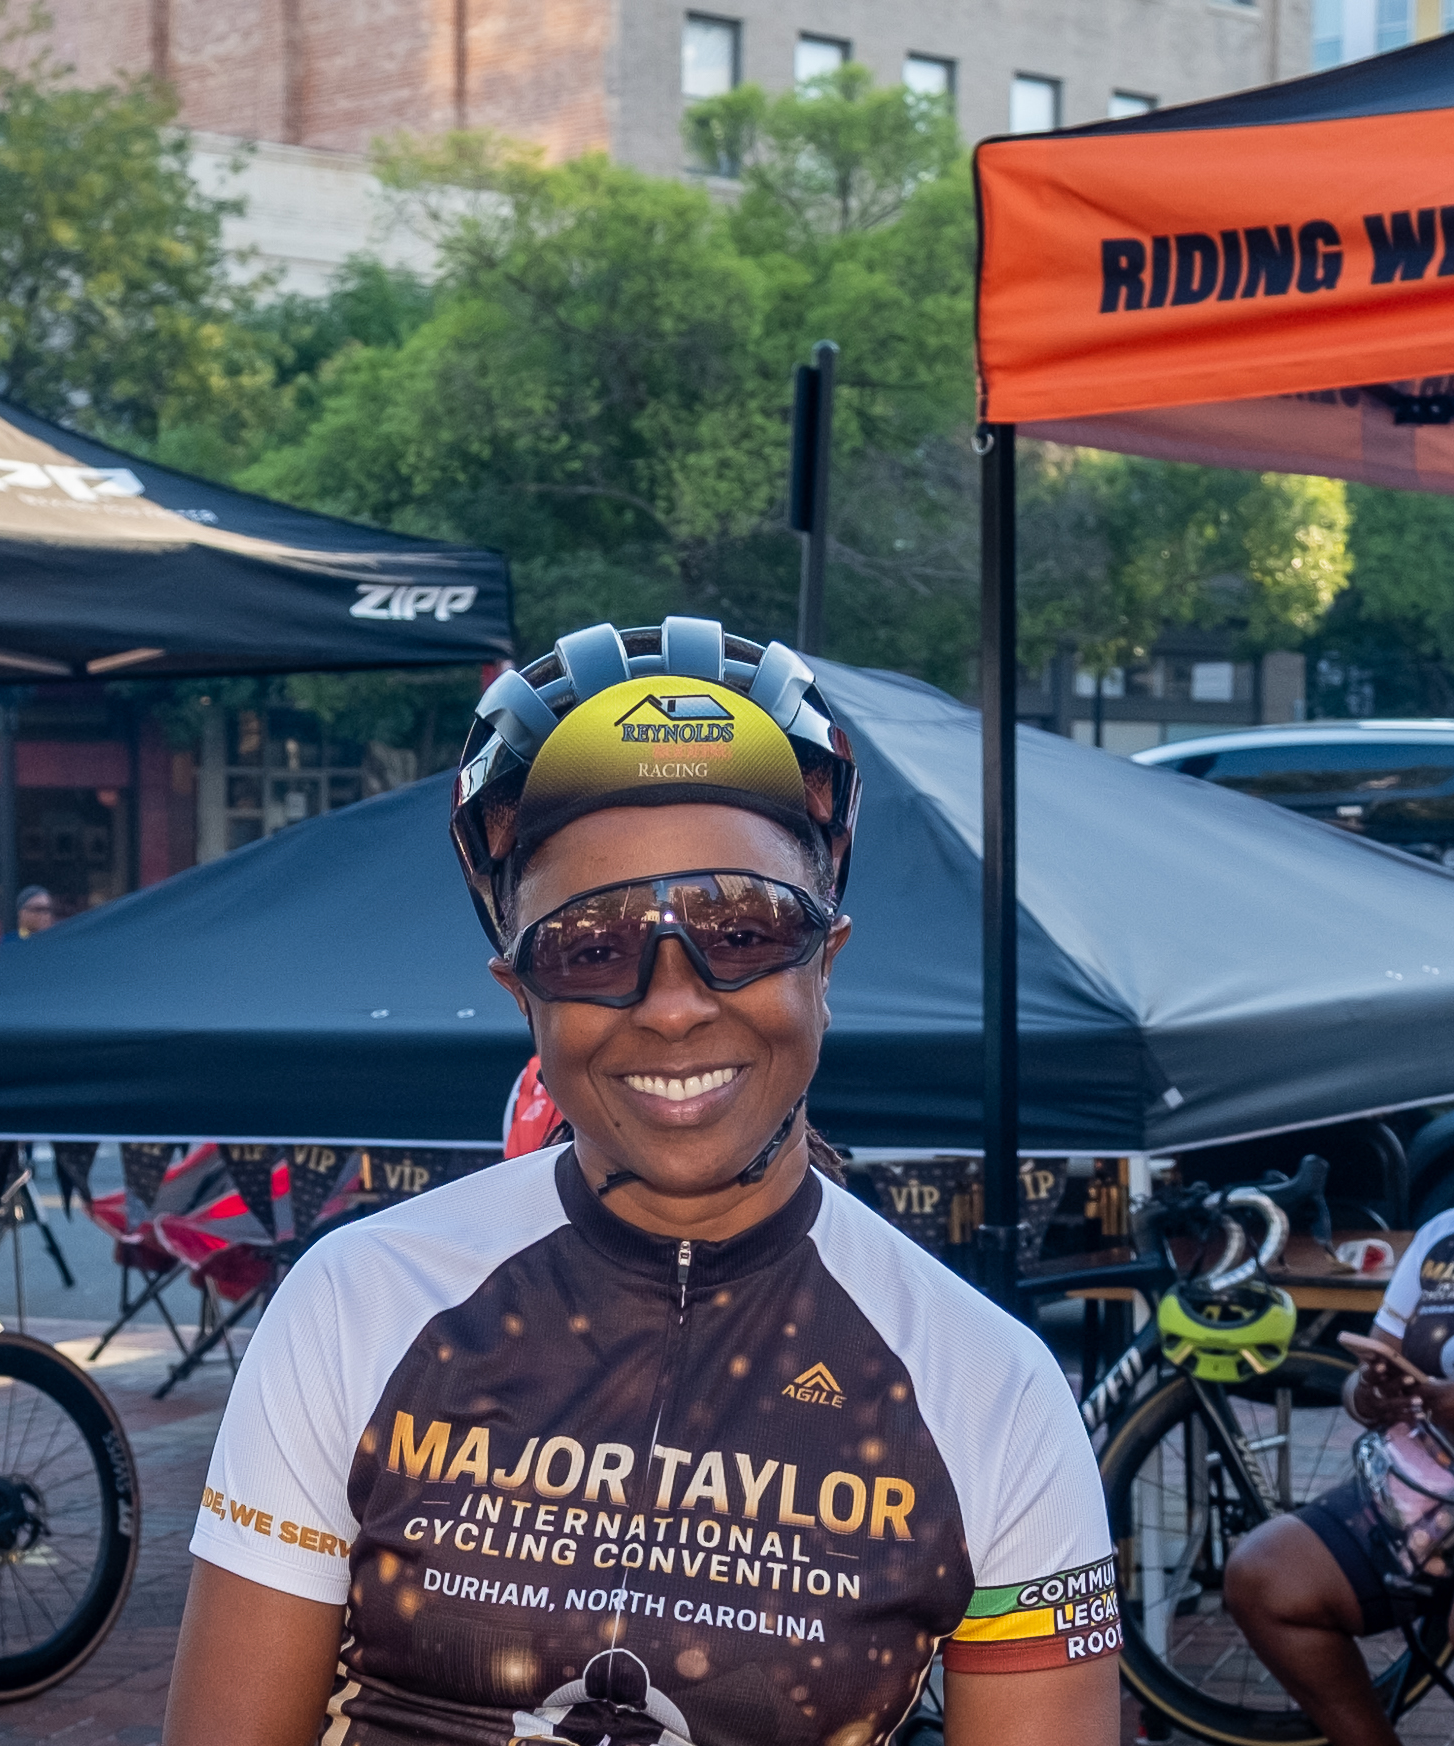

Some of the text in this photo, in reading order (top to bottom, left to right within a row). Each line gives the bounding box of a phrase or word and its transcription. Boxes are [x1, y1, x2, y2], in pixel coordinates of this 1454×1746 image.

[1100, 221, 1342, 314] RIDING
[348, 583, 477, 622] ZIPP
[622, 723, 735, 744] REYNOLDS
[638, 762, 709, 779] RACING
[382, 1159, 431, 1193] VIP
[1020, 1169, 1056, 1201] IP
[889, 1178, 941, 1215] VIP
[781, 1383, 847, 1409] AGILE
[386, 1410, 916, 1541] MAJOR TAYLOR
[230, 1500, 273, 1536] WE
[459, 1493, 811, 1563] INTERNATIONAL
[403, 1516, 861, 1600] CYCLING CONVENTION
[422, 1567, 826, 1643] DURHAM, NORTH CAROLINA
